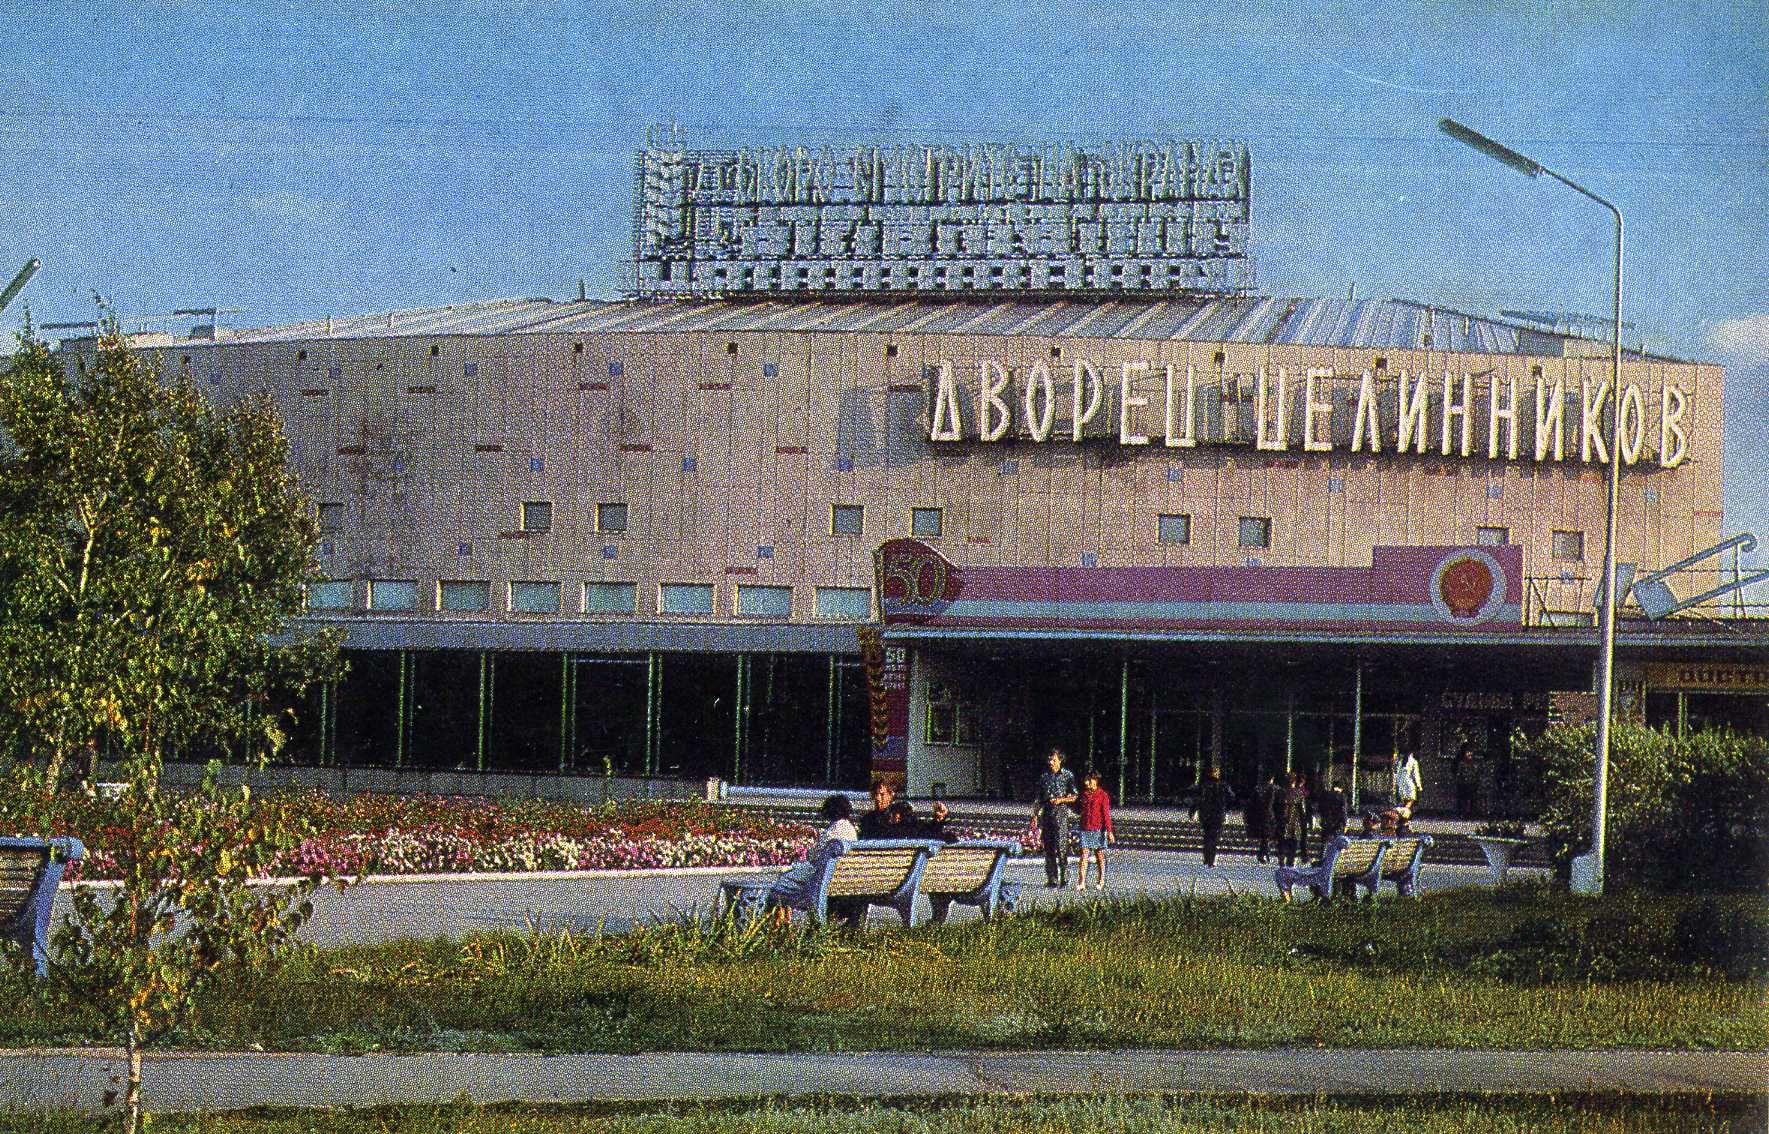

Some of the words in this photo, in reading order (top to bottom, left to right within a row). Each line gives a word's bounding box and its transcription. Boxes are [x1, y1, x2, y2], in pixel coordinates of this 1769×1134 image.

[930, 359, 1197, 448] ДВОРЕЦ
[1256, 365, 1690, 469] ЦЕЛИННИКОВ
[883, 552, 947, 605] 50
[885, 647, 906, 663] 50
